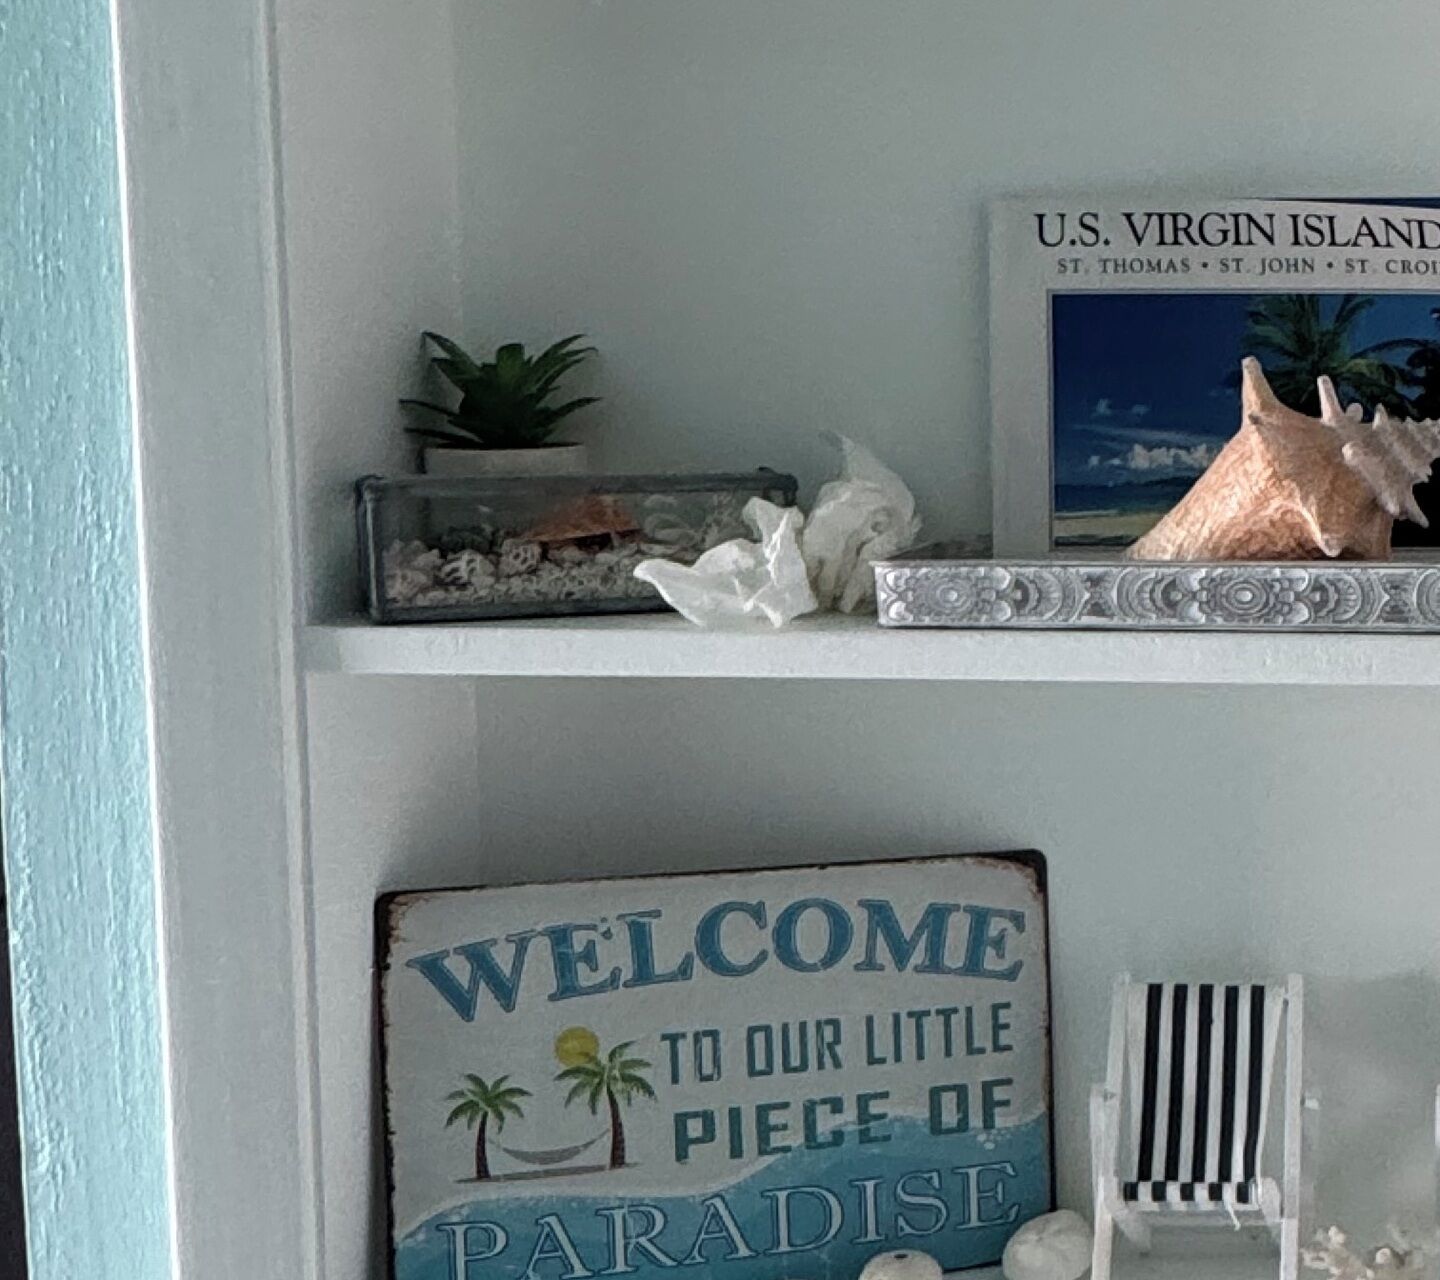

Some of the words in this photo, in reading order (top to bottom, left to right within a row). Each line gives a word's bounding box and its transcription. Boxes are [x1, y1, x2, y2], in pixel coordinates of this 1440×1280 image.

[1033, 211, 1111, 248] U.S.
[1121, 212, 1279, 248] VIRGIN
[1056, 257, 1091, 275] ST.
[1098, 257, 1192, 275] THOMAS
[1218, 257, 1253, 275] ST.
[1257, 257, 1316, 276] JOHN
[1344, 258, 1379, 275] ST.
[405, 896, 1028, 1022] WELCOME
[660, 1029, 722, 1085] TO
[745, 1017, 843, 1077] OUR
[865, 1001, 1014, 1067] LITTLE
[672, 1090, 893, 1163] PIECE
[928, 1077, 1015, 1136] OF
